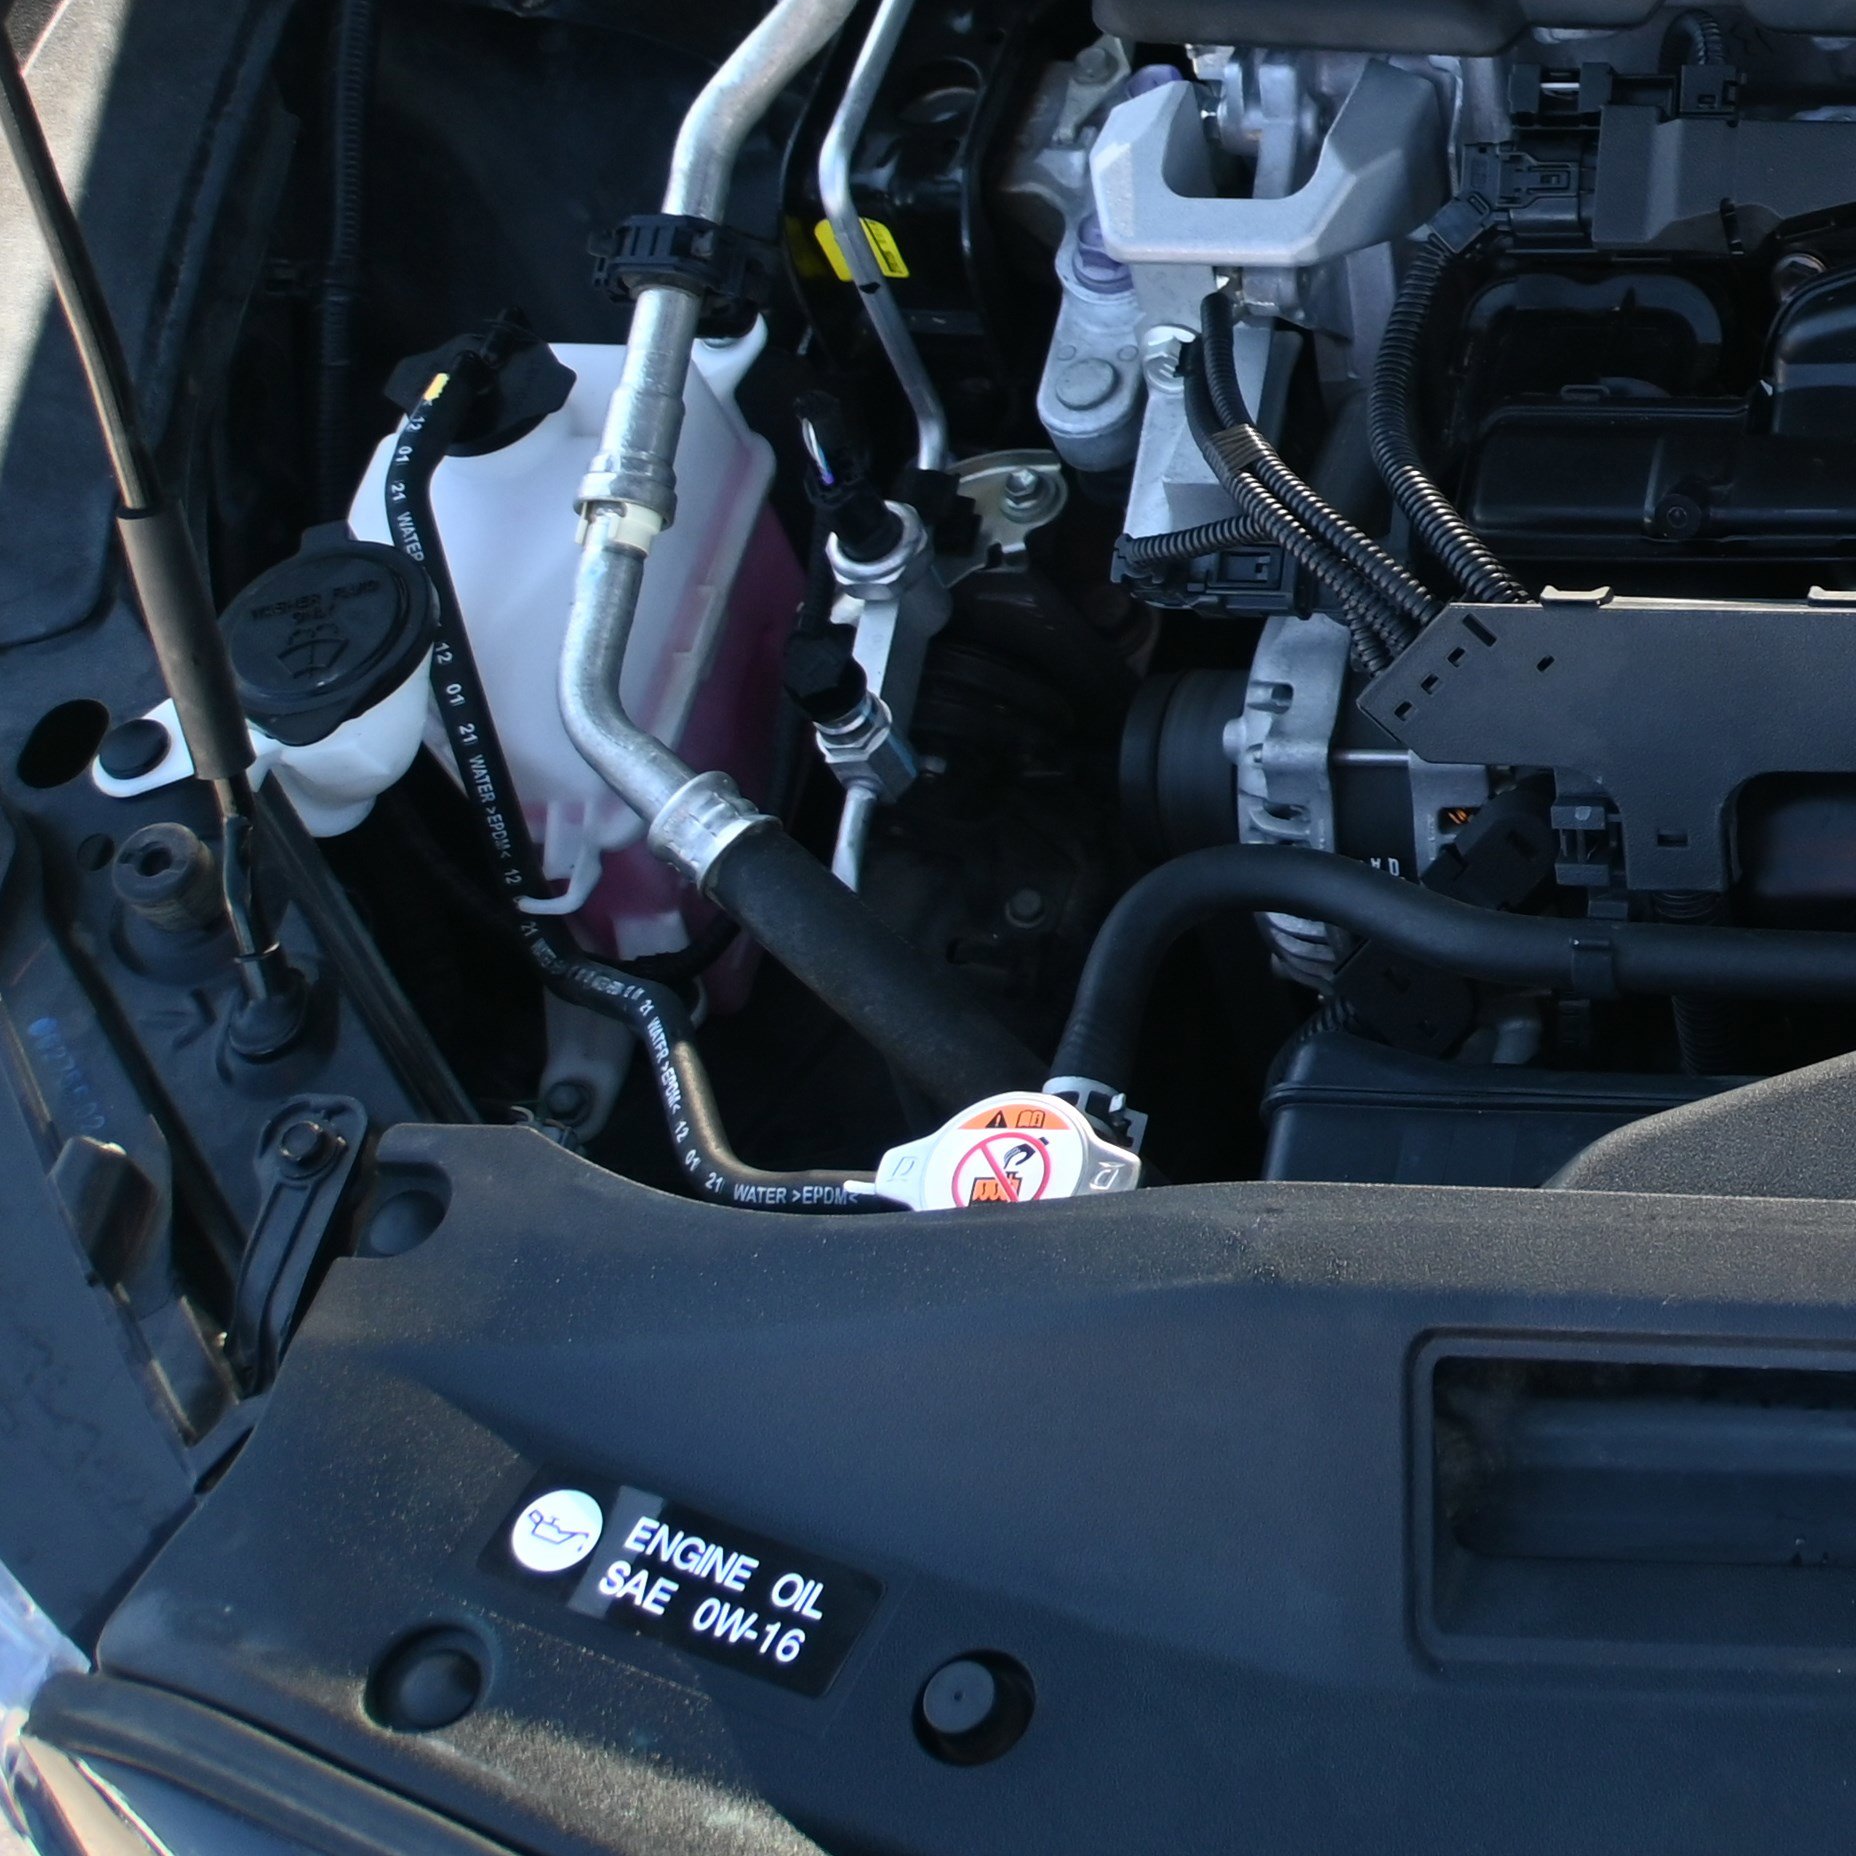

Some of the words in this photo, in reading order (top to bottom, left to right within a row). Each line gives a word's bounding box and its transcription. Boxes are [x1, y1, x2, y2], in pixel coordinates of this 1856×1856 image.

[395, 446, 413, 463] 01
[406, 416, 425, 432] 12
[391, 482, 407, 502] 21
[435, 642, 453, 665] 12
[446, 683, 465, 706] 01
[458, 723, 478, 745] 21
[469, 754, 496, 804] WATER
[504, 868, 522, 885] 12
[674, 1120, 690, 1143] 12
[685, 1149, 701, 1172] 01
[705, 1172, 724, 1194] 21
[733, 1184, 787, 1205] WATER
[792, 1186, 858, 1205] >EPDM<
[623, 1516, 760, 1592] ENGINE
[770, 1572, 824, 1621] OIL
[599, 1560, 680, 1616] SAE
[692, 1597, 806, 1663] 0W-16
